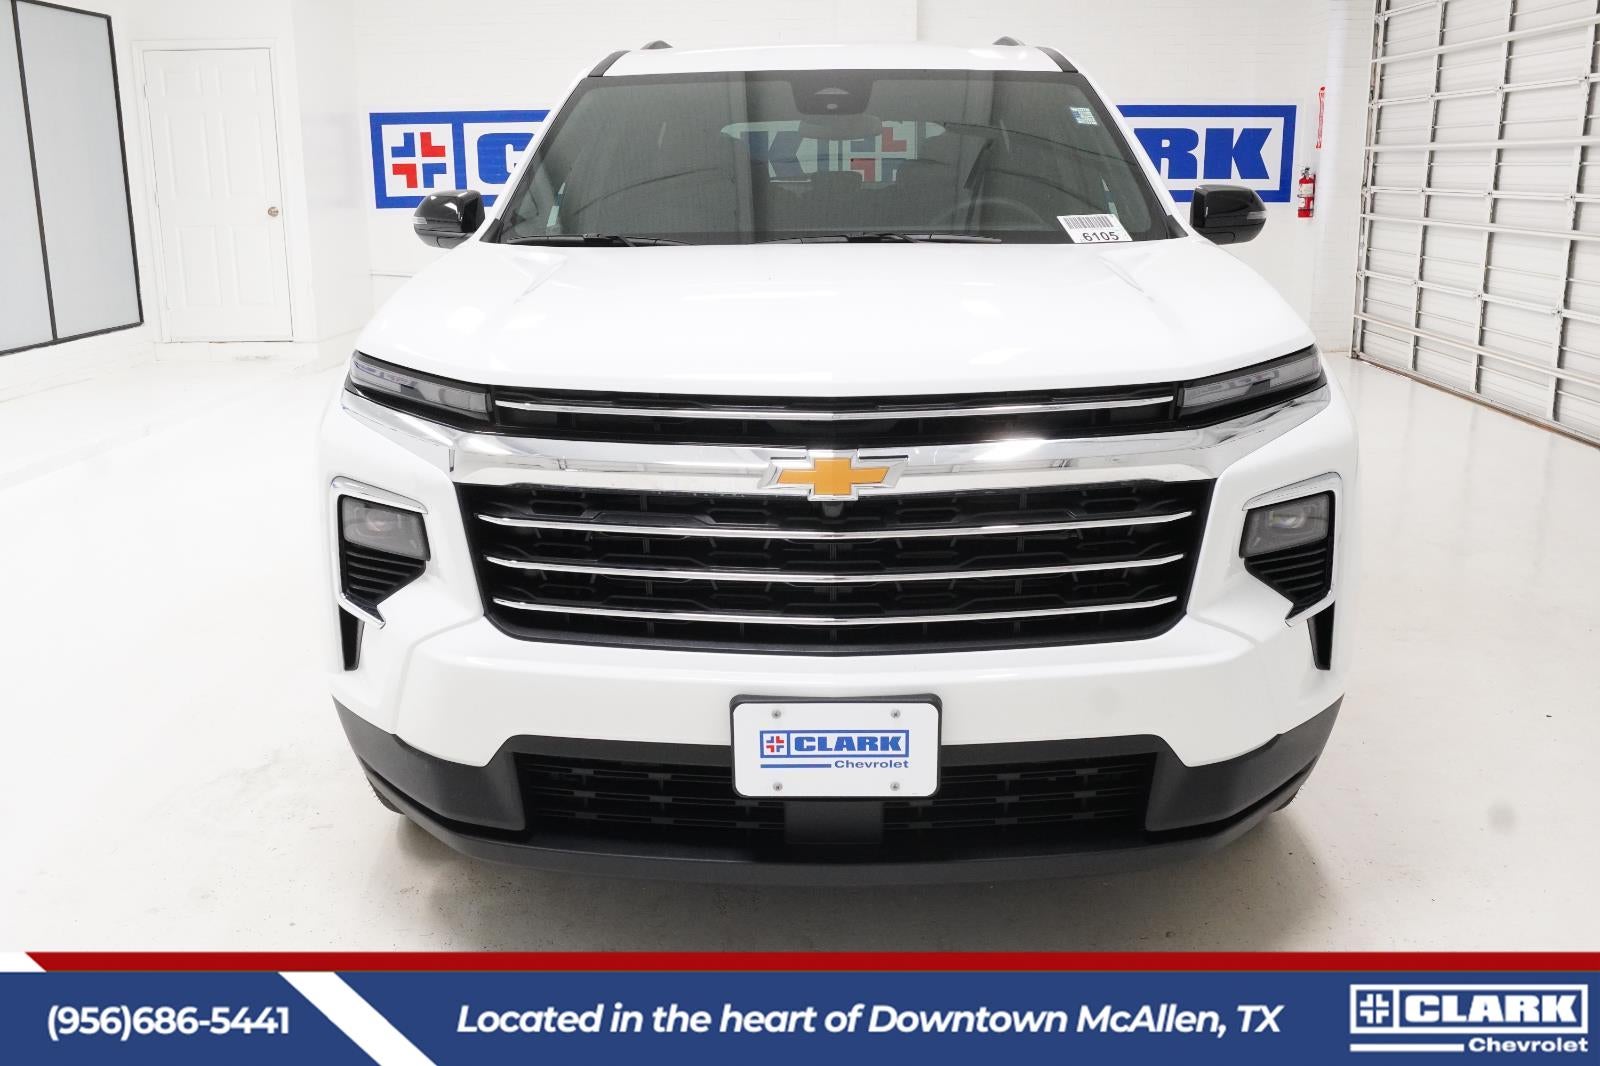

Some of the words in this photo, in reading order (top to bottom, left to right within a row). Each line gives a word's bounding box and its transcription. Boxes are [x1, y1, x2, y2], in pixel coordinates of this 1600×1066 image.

[1082, 231, 1120, 242] 6105
[794, 736, 902, 752] CLARK
[834, 760, 909, 769] Chevrolet
